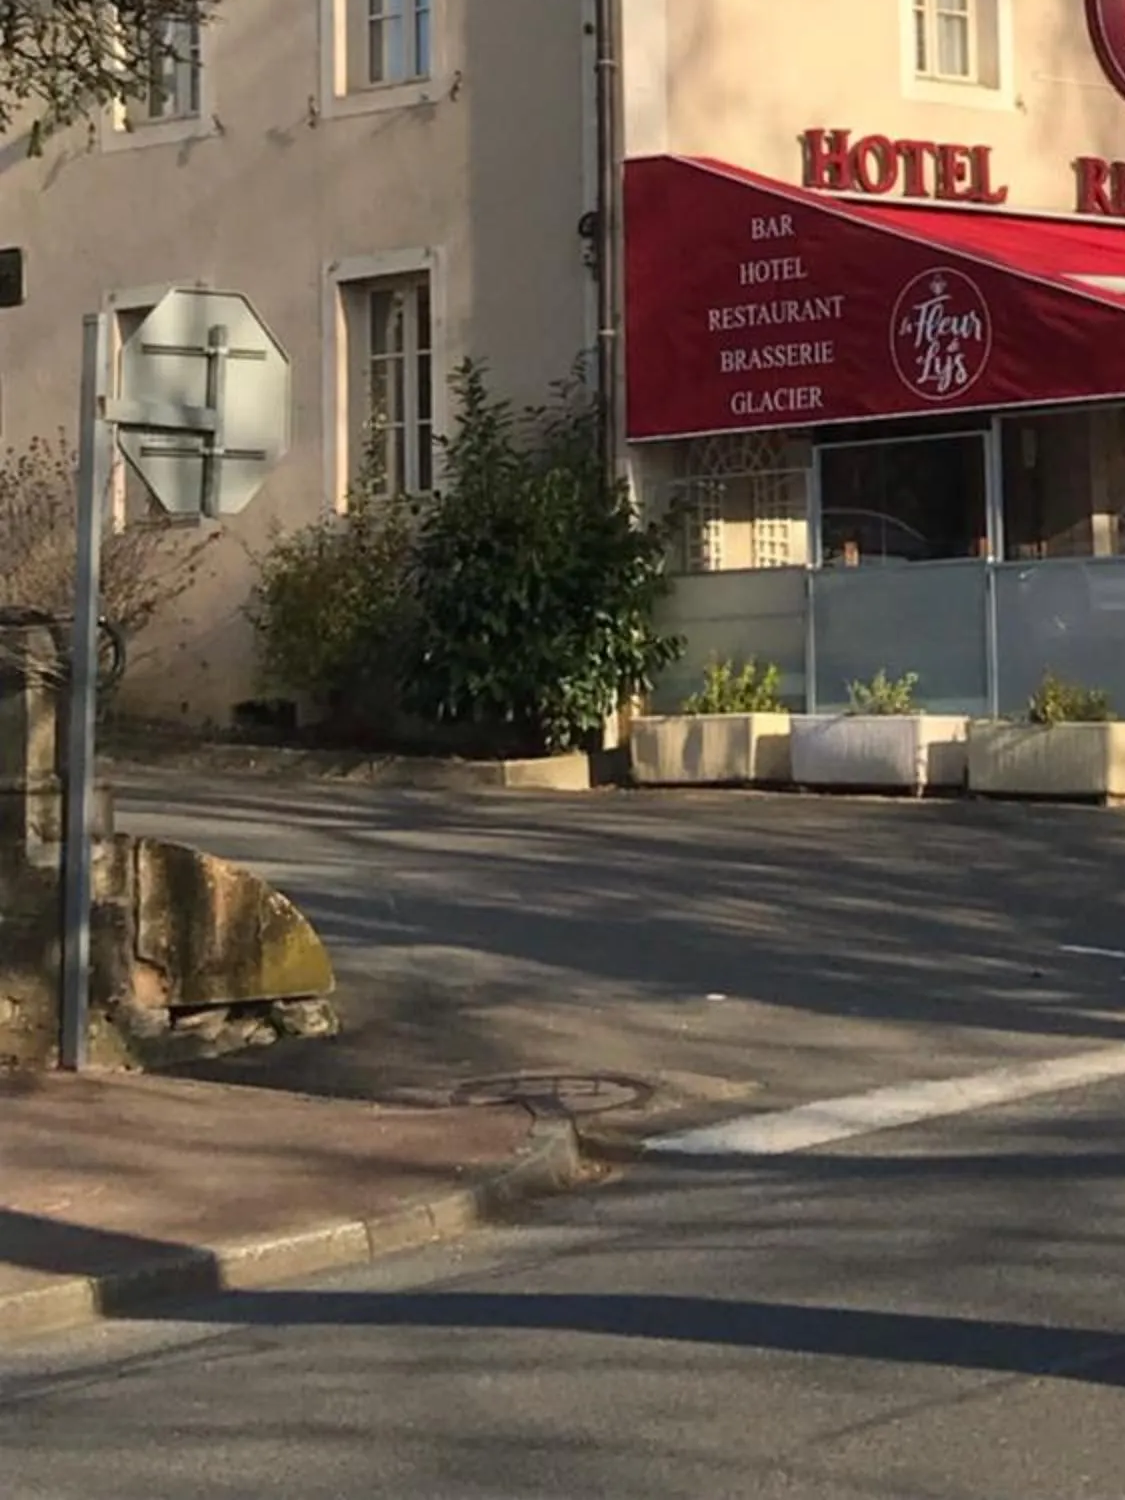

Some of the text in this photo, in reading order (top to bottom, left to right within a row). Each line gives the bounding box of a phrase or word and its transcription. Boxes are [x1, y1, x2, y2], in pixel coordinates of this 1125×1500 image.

[799, 128, 1008, 202] HOTEL
[751, 214, 795, 240] BAR
[738, 257, 808, 285] HOTEL
[708, 295, 845, 331] RESTAURANT
[913, 295, 982, 348] Fleur
[720, 341, 834, 373] BRASSERIE
[916, 341, 968, 392] Lys
[730, 386, 824, 415] GLACIER
